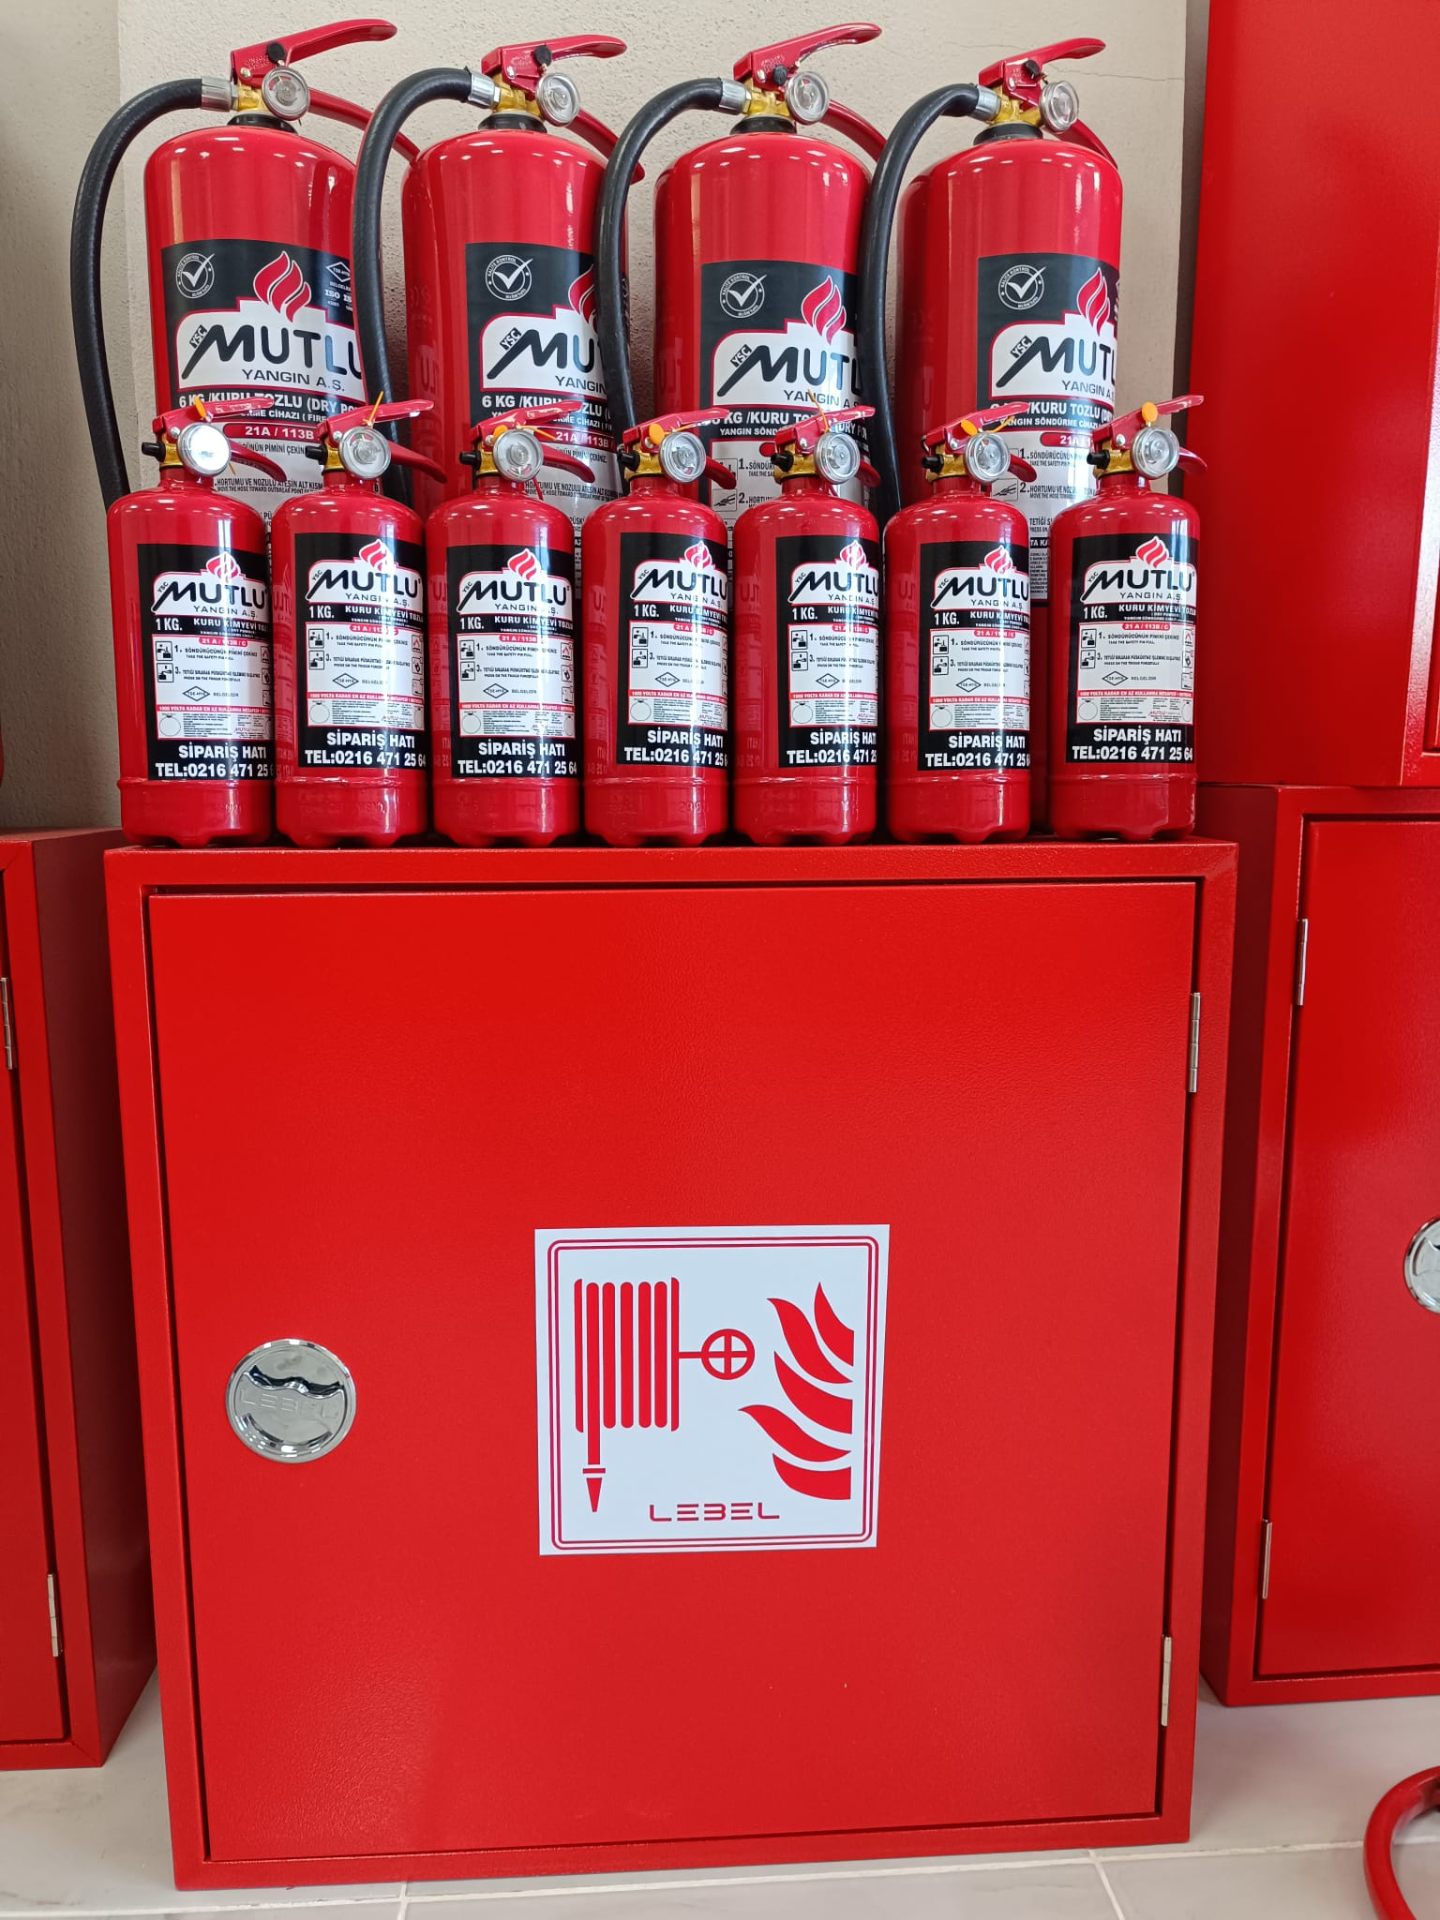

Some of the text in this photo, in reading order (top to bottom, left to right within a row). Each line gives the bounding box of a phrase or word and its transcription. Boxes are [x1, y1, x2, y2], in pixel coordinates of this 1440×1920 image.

[190, 326, 208, 349] YSC
[500, 328, 521, 350] YSC
[1010, 336, 1031, 358] YSC
[730, 344, 752, 368] YSC
[242, 369, 310, 386] YANGIN
[1062, 380, 1105, 397] YANGIN
[179, 395, 190, 408] 6
[481, 395, 491, 408] 6
[495, 395, 516, 408] KG
[784, 389, 841, 407] YANGIN
[746, 412, 789, 425] /KURU
[1071, 404, 1102, 420] TOZLU
[1035, 416, 1077, 428] SÖNDÜRME
[245, 425, 315, 440] 21A / 113B
[720, 427, 749, 436] YANGIN
[1020, 448, 1030, 460] 1.
[739, 458, 749, 470] 1.
[1020, 482, 1030, 493] 2.
[739, 492, 749, 504] 2.
[307, 568, 418, 599] MUTLU
[1081, 569, 1192, 602] MUTLU
[152, 581, 265, 611] MUTLU
[458, 580, 567, 611] MUTLU
[932, 576, 1029, 608] MUTLU
[1119, 592, 1164, 600] YANGIN
[309, 604, 335, 619] 1 KG.
[345, 605, 371, 615] KURU
[495, 602, 537, 612] YANGIN
[634, 604, 660, 618] 1 KG.
[792, 606, 818, 621] 1 KG.
[1083, 606, 1109, 620] 1 KG.
[1119, 603, 1180, 615] KURU KİMYEVİ
[194, 618, 221, 627] KURU
[460, 619, 467, 631] 1
[468, 616, 485, 631] KG.
[495, 616, 521, 624] KURU
[933, 611, 960, 626] 1 KG.
[970, 611, 995, 620] KURU
[156, 618, 183, 631] 1 KG.
[327, 728, 416, 751] SİPARİŞ HATI
[704, 733, 724, 749] HATI
[810, 728, 860, 748] SİPARİŞ
[948, 731, 1026, 752] SİPARİŞ HATI
[1093, 724, 1182, 746] SİPARİŞ HATI
[178, 742, 267, 762] SİPARİŞ HATI
[478, 738, 565, 759] SİPARİŞ HATI
[624, 747, 690, 764] TEL:0216
[692, 750, 713, 765] 471
[1072, 745, 1137, 761] TEL:0216
[1141, 746, 1166, 761] 471
[1169, 746, 1183, 761] 25
[305, 750, 373, 765] TEL:0216
[377, 751, 401, 766] 471
[404, 753, 416, 767] 25
[786, 749, 870, 765] TEL:0216 471
[925, 752, 1026, 768] TEL:0216 471 25
[155, 762, 268, 778] TEL:0216 471 25
[457, 759, 524, 775] TEL:0216
[527, 760, 551, 775] 471
[554, 761, 567, 775] 25
[650, 1502, 779, 1522] LEBEL
